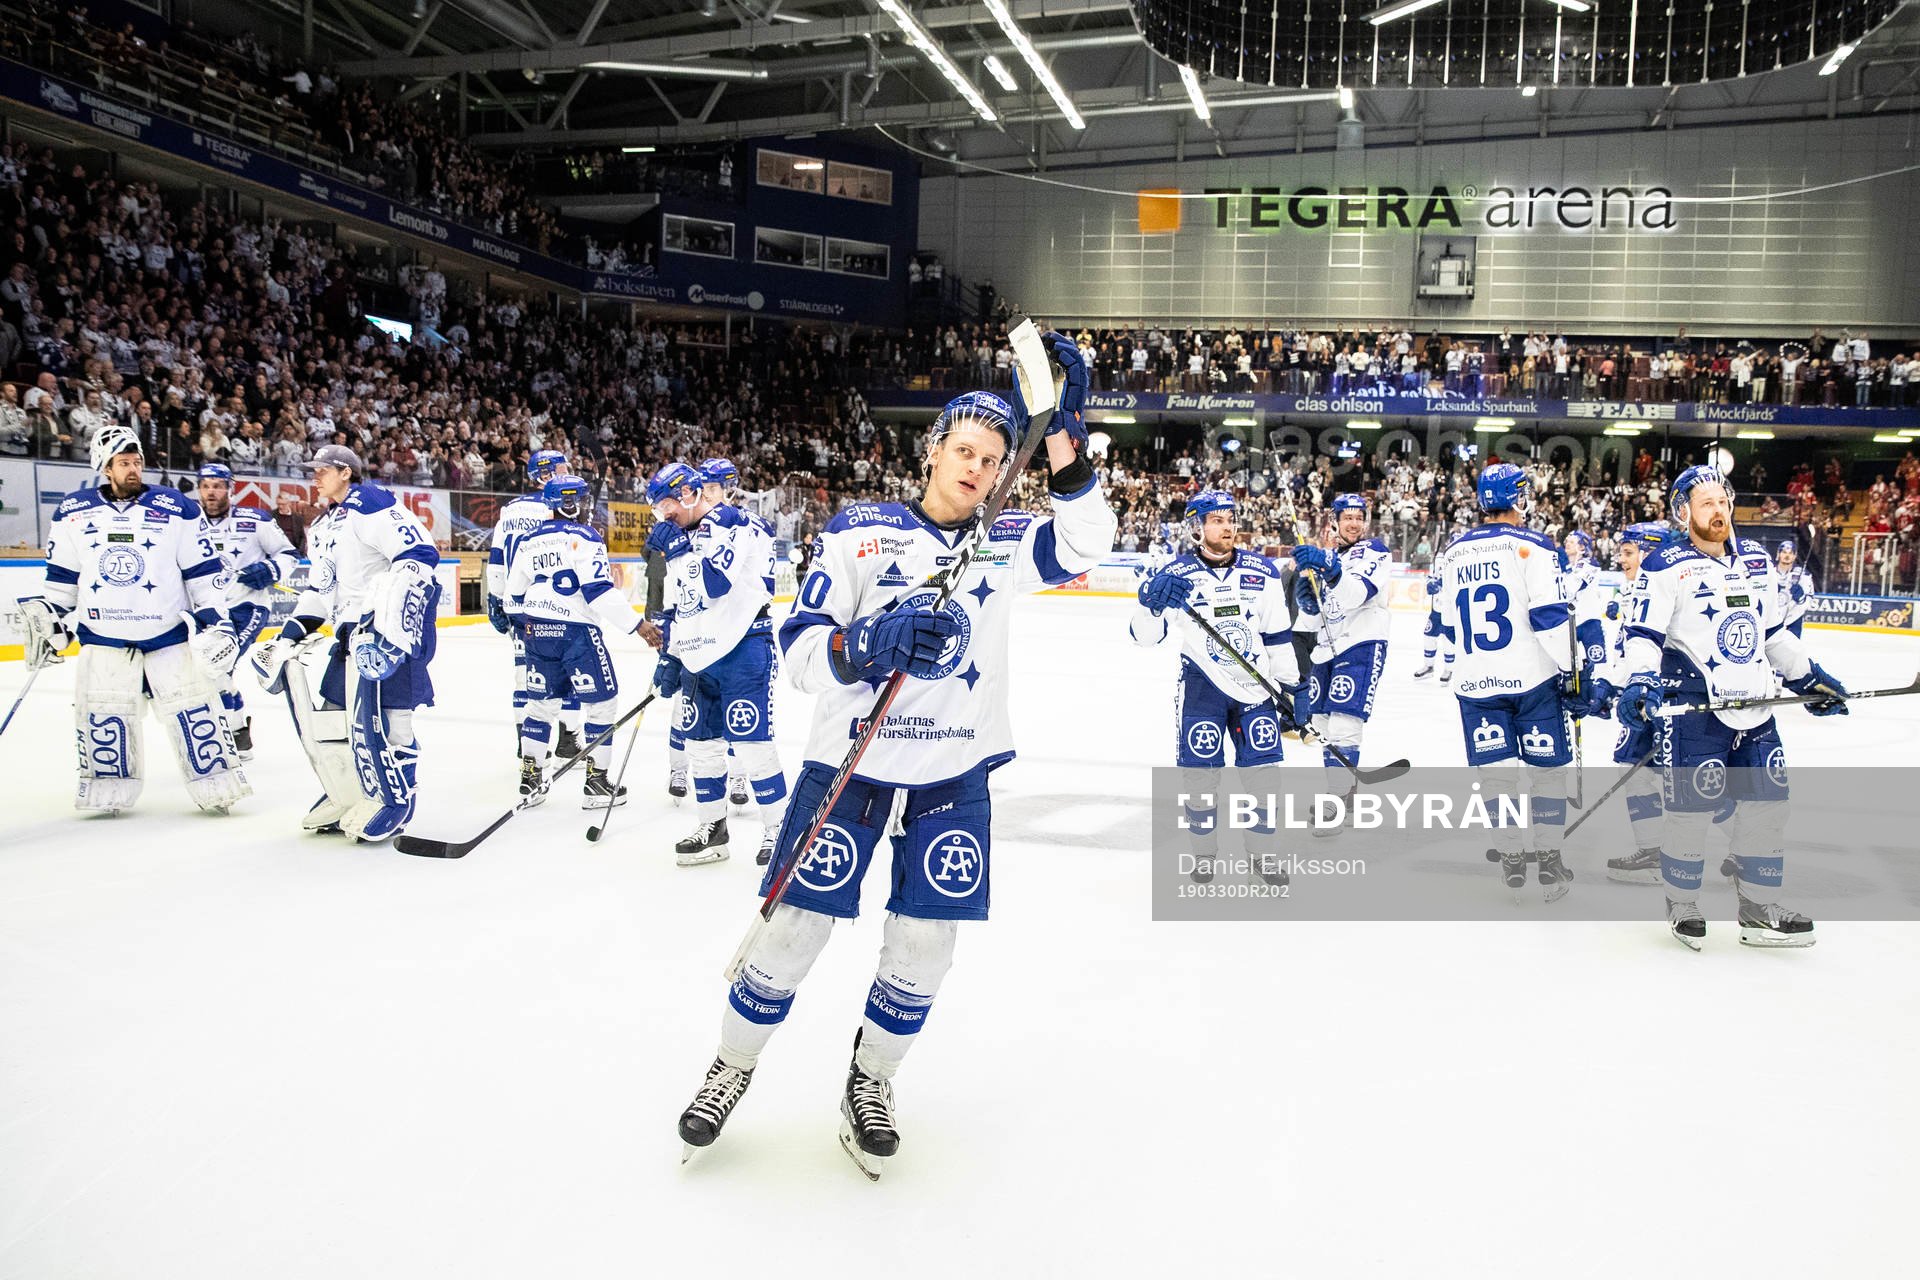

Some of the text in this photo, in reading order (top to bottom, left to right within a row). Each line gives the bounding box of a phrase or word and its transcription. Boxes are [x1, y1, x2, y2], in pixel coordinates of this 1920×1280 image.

[1485, 186, 1676, 229] arena
[389, 205, 434, 236] Lemont
[608, 277, 675, 299] bokstaven
[1295, 396, 1383, 412] clas ohlson
[1426, 399, 1537, 415] Leksands Sparbank
[1585, 403, 1661, 419] PEAB
[845, 505, 881, 516] clas
[848, 511, 903, 526] ohlson
[398, 524, 424, 546] 31
[711, 544, 735, 570] 29
[973, 553, 1011, 563] dalakraft
[1241, 560, 1272, 575] ohlson
[1456, 560, 1501, 584] KNUTS
[533, 623, 567, 631] LEKSANDS
[1455, 583, 1514, 655] 13
[1479, 676, 1522, 690] ohlson
[881, 715, 935, 727] Dalarnas
[218, 715, 237, 756] CCM
[750, 963, 773, 981] CCM
[891, 974, 917, 988] CCM
[738, 992, 754, 1010] KARL
[755, 1004, 780, 1014] HEDIN
[879, 1001, 897, 1019] KARL
[897, 1011, 922, 1022] HEDIN
